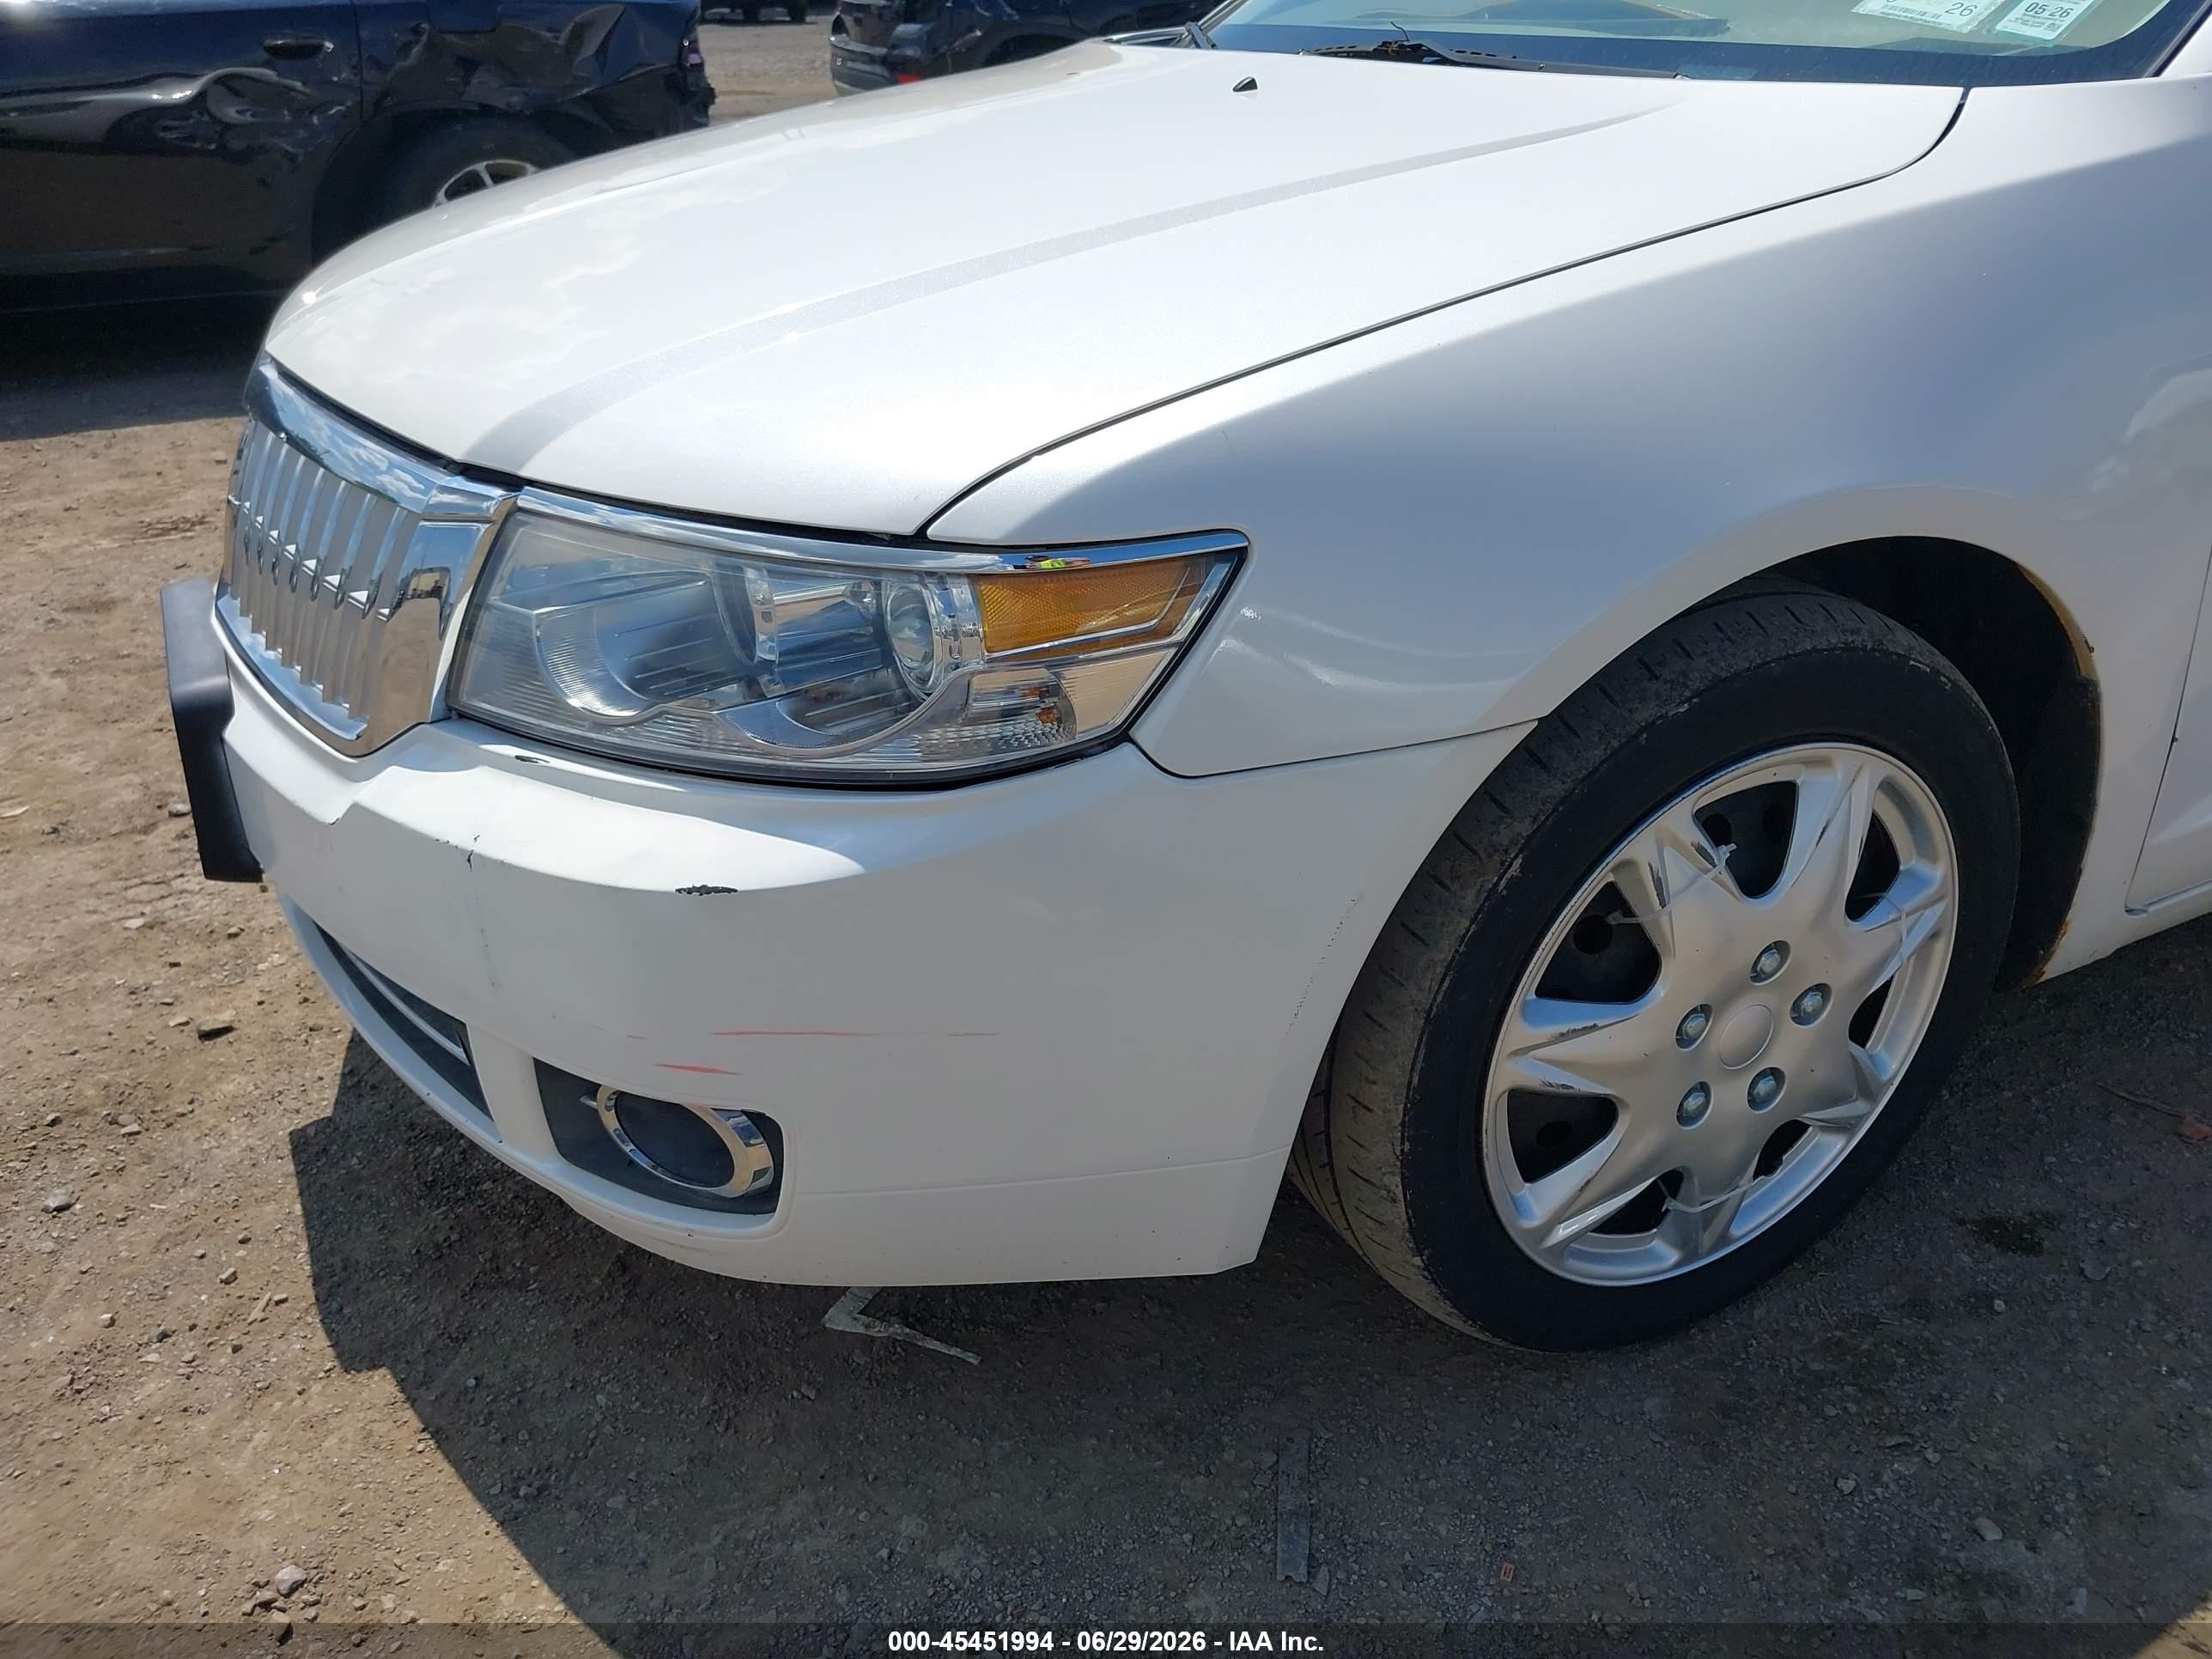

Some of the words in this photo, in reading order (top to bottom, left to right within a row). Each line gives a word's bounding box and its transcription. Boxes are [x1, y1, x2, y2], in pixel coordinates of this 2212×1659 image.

[1944, 2, 1978, 17] 26
[2024, 2, 2050, 15] 05
[2047, 6, 2075, 19] 26
